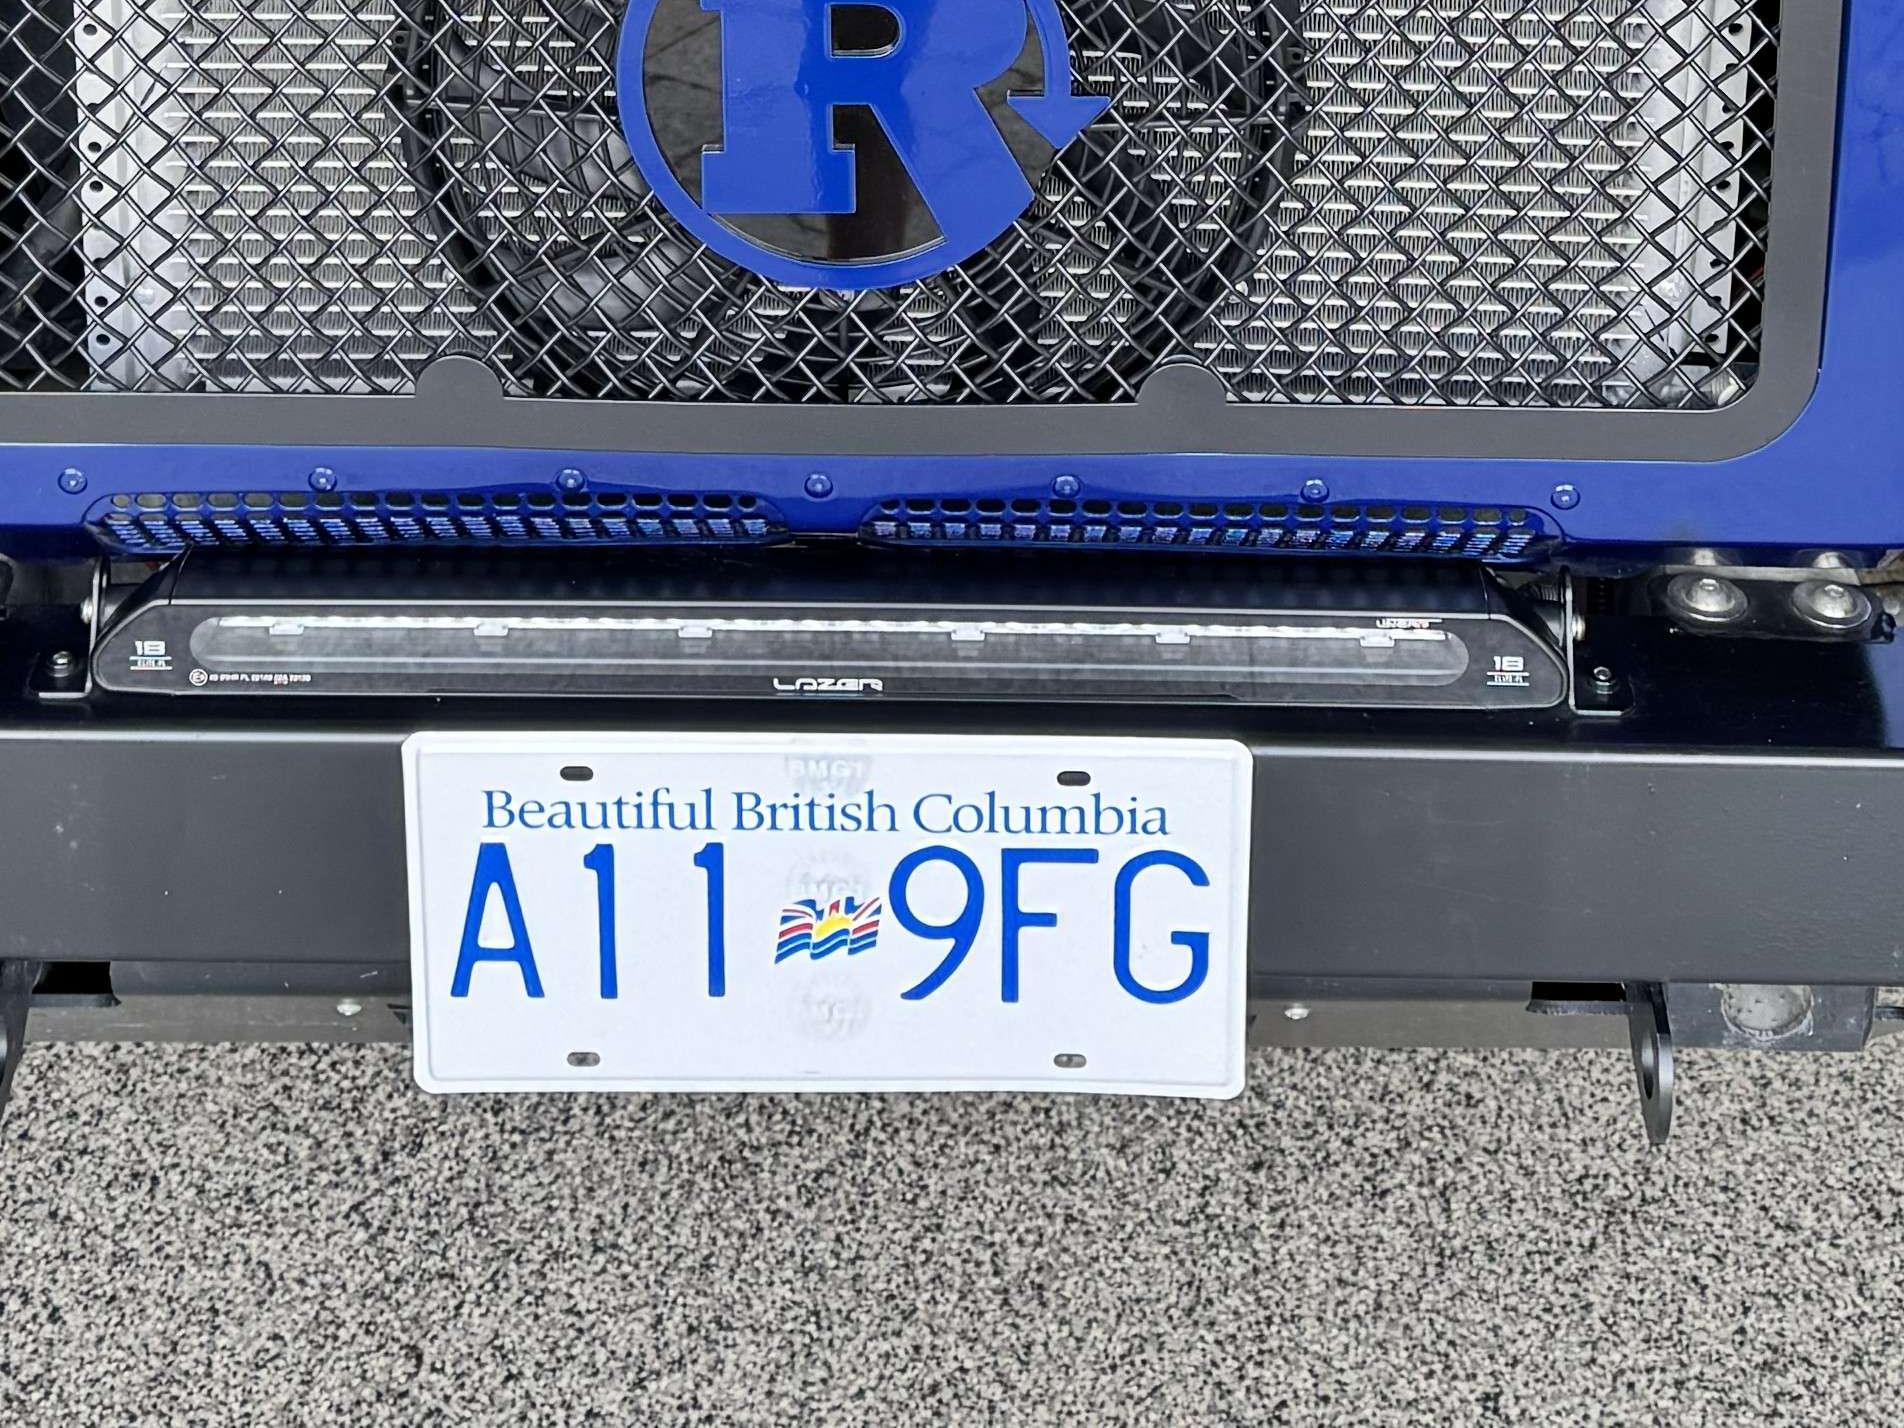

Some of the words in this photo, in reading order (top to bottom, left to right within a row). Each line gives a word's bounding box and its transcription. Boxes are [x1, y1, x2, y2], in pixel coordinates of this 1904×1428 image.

[134, 640, 166, 656] 18
[1493, 655, 1524, 672] 18
[772, 676, 884, 692] LAZER
[482, 786, 714, 832] Beautiful
[732, 789, 900, 834] British
[911, 790, 1171, 837] Columbia
[448, 840, 728, 1001] A11
[887, 842, 1212, 1007] 9FG
